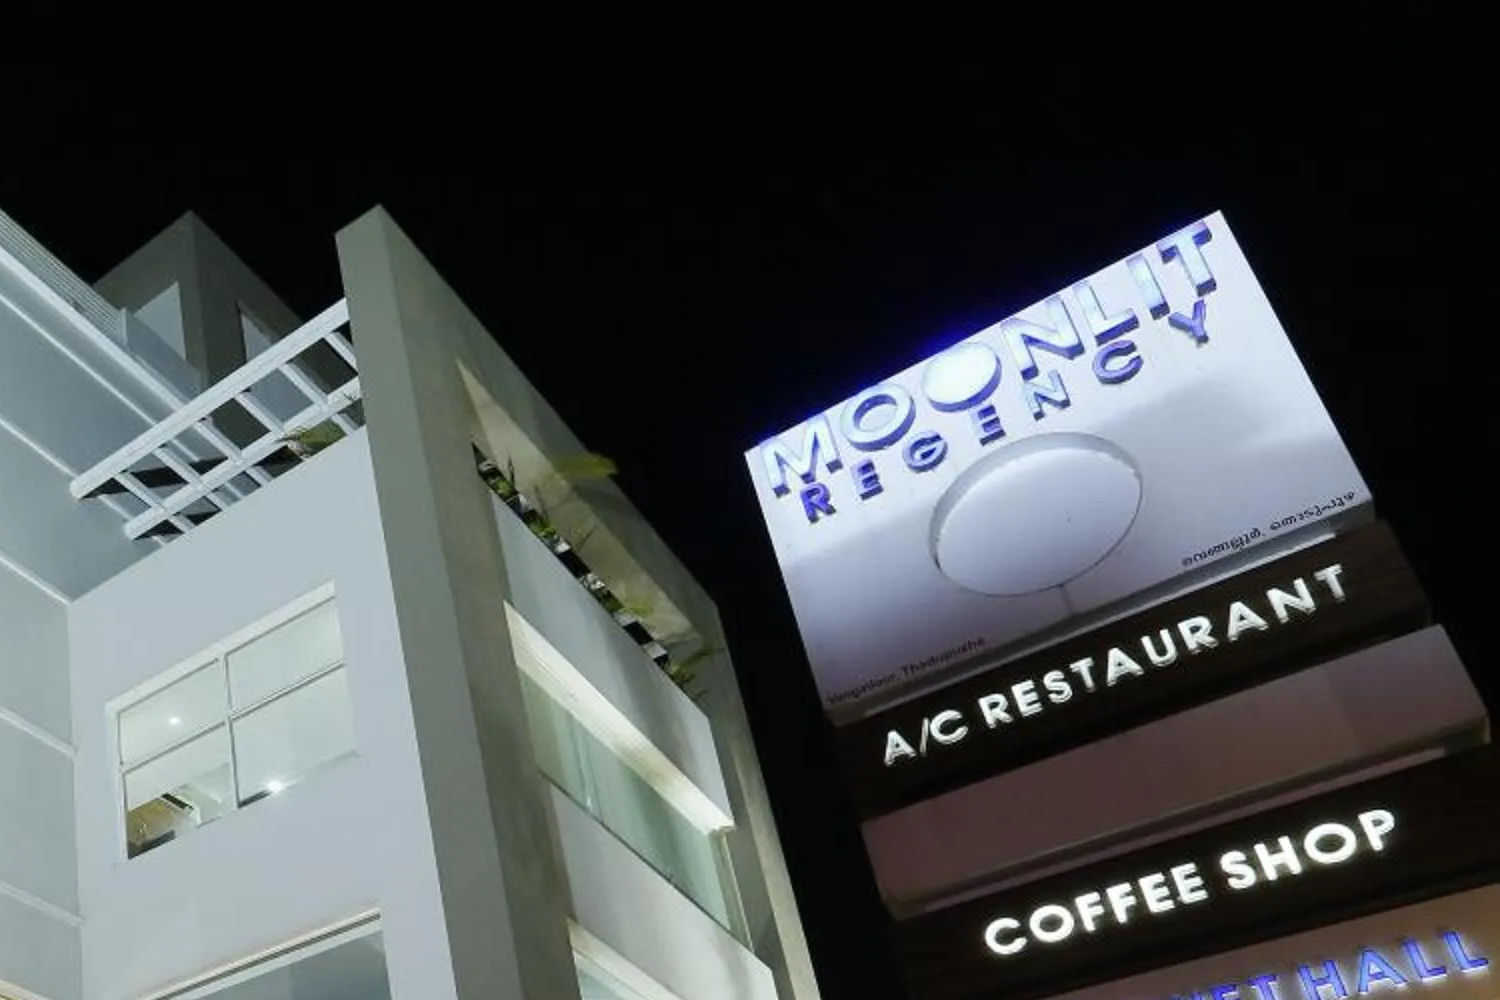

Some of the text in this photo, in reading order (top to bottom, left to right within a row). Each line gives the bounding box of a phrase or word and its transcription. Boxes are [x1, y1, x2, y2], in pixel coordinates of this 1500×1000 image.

[756, 219, 1216, 497] MOONLIT
[800, 299, 1209, 523] REGENCY
[883, 563, 1346, 767] A/C RESTAURANT
[984, 808, 1396, 955] COFFEE SHOP
